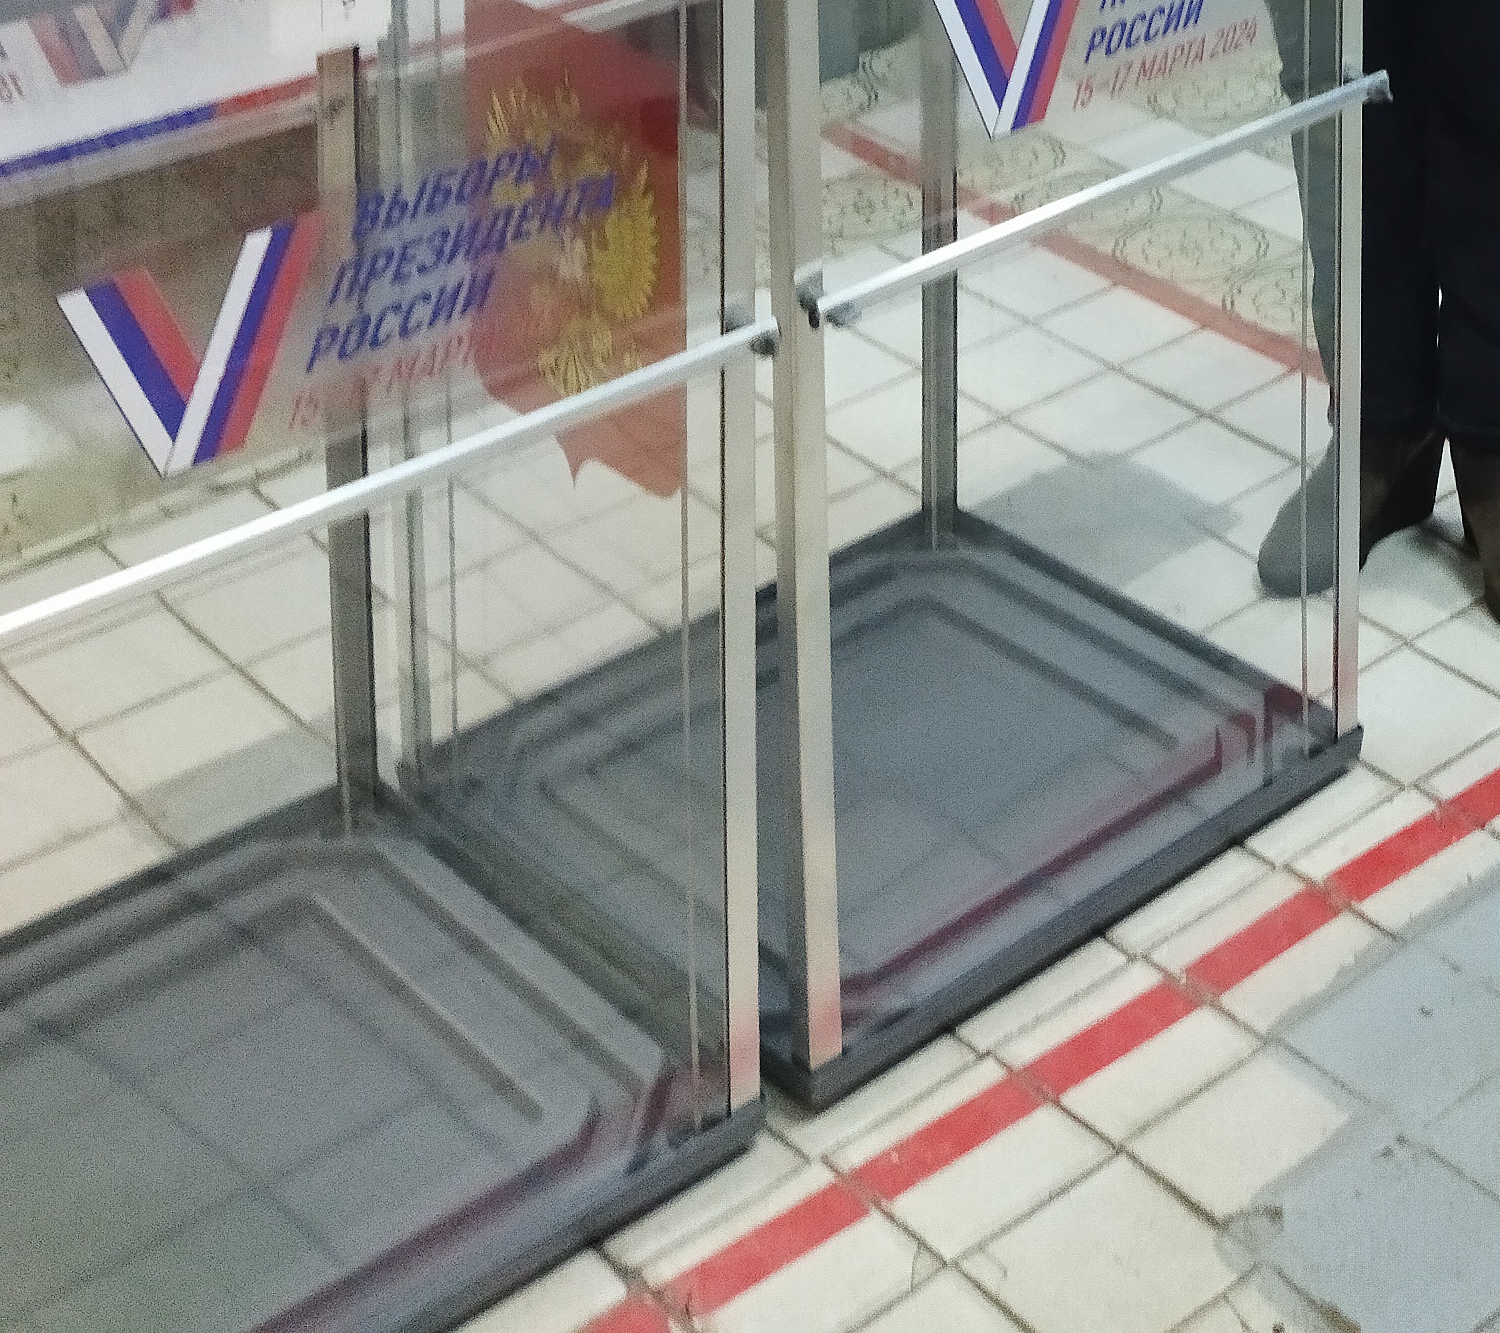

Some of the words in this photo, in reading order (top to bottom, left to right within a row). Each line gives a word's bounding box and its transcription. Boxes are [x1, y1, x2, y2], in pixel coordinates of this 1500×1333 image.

[1134, 33, 1207, 86] МАРТА
[1209, 15, 1258, 61] 2024
[354, 136, 556, 239] ВЫБОРЫ
[305, 263, 497, 374] РОССИИ
